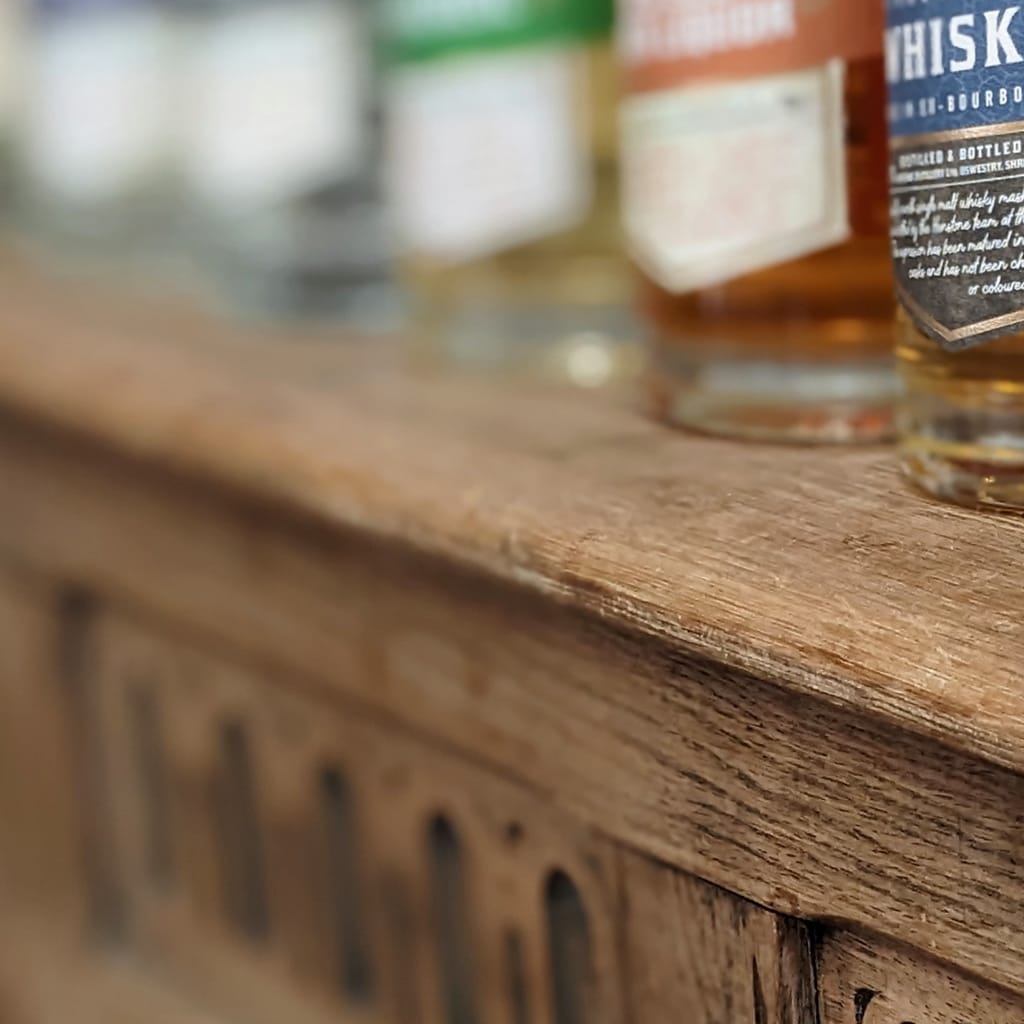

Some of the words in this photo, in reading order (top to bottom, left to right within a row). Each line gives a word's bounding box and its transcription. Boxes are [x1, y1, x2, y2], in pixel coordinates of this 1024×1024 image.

[959, 140, 1022, 160] BOTTLED
[959, 189, 996, 213] whisky
[1001, 208, 1015, 226] at
[968, 231, 1013, 253] matured
[943, 260, 960, 276] has
[961, 261, 979, 275] not
[979, 257, 1009, 273] been
[968, 283, 980, 295] or
